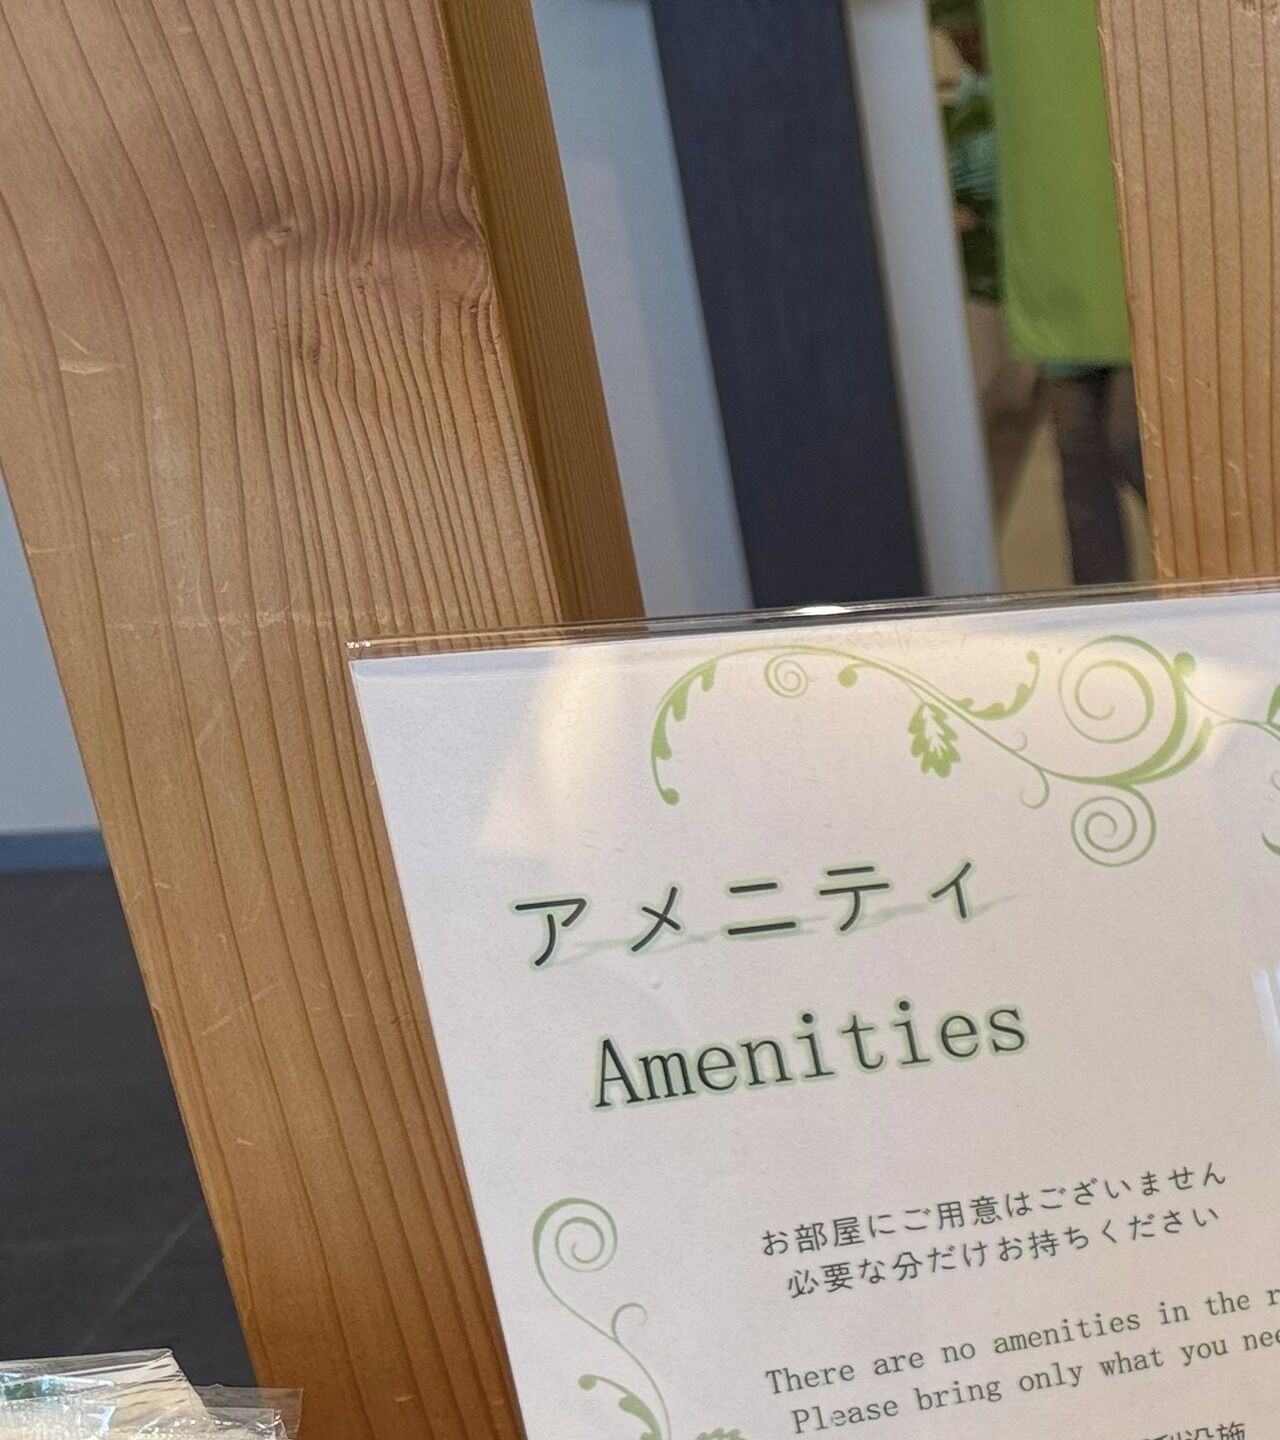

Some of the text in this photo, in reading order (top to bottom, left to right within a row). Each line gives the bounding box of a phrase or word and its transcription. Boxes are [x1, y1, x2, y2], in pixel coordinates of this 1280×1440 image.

[512, 860, 974, 967] アメニティ
[593, 999, 1027, 1108] Amenities
[761, 1162, 1227, 1258] お部屋にご用意はございません
[786, 1203, 1221, 1300] 必要な分だけお持ちください
[764, 1355, 857, 1396] There
[872, 1348, 926, 1378] are
[940, 1338, 978, 1365] no
[991, 1306, 1142, 1356] amenities
[1157, 1299, 1189, 1326] in
[1203, 1288, 1251, 1318] the
[790, 1393, 900, 1436] Please
[914, 1374, 1002, 1412] bring
[1016, 1359, 1083, 1393] only
[1098, 1344, 1165, 1378] what
[1178, 1335, 1228, 1366] you
